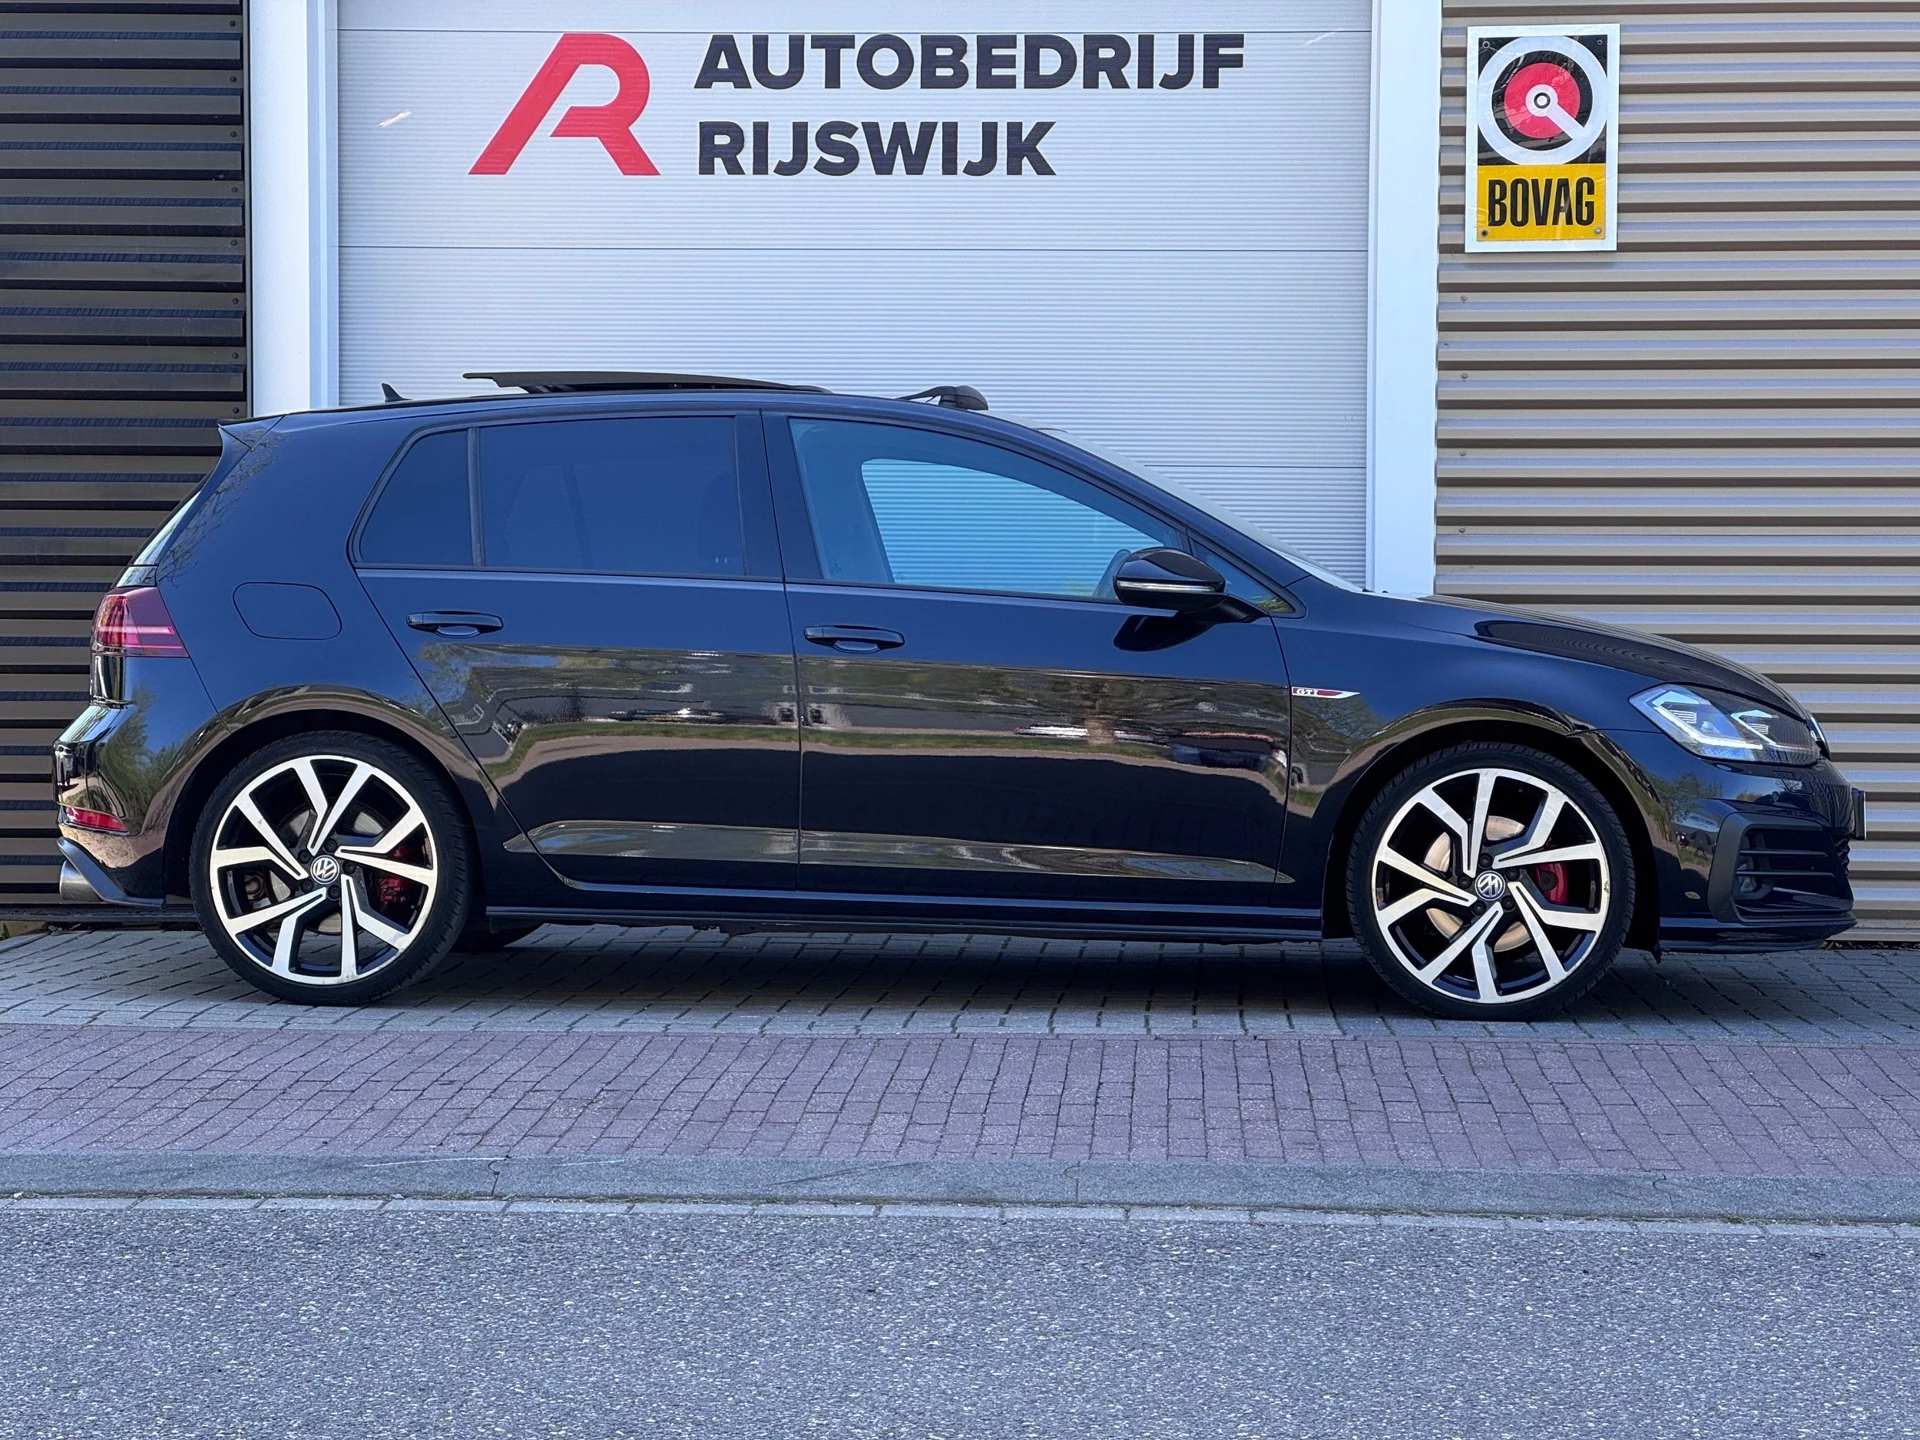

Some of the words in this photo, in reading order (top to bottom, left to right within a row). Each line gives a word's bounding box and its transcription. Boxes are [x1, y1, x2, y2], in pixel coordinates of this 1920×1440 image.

[694, 33, 1245, 90] AUTOBEDRIJF
[698, 120, 1056, 177] RIJSWIJK
[1487, 176, 1595, 228] BOVAG
